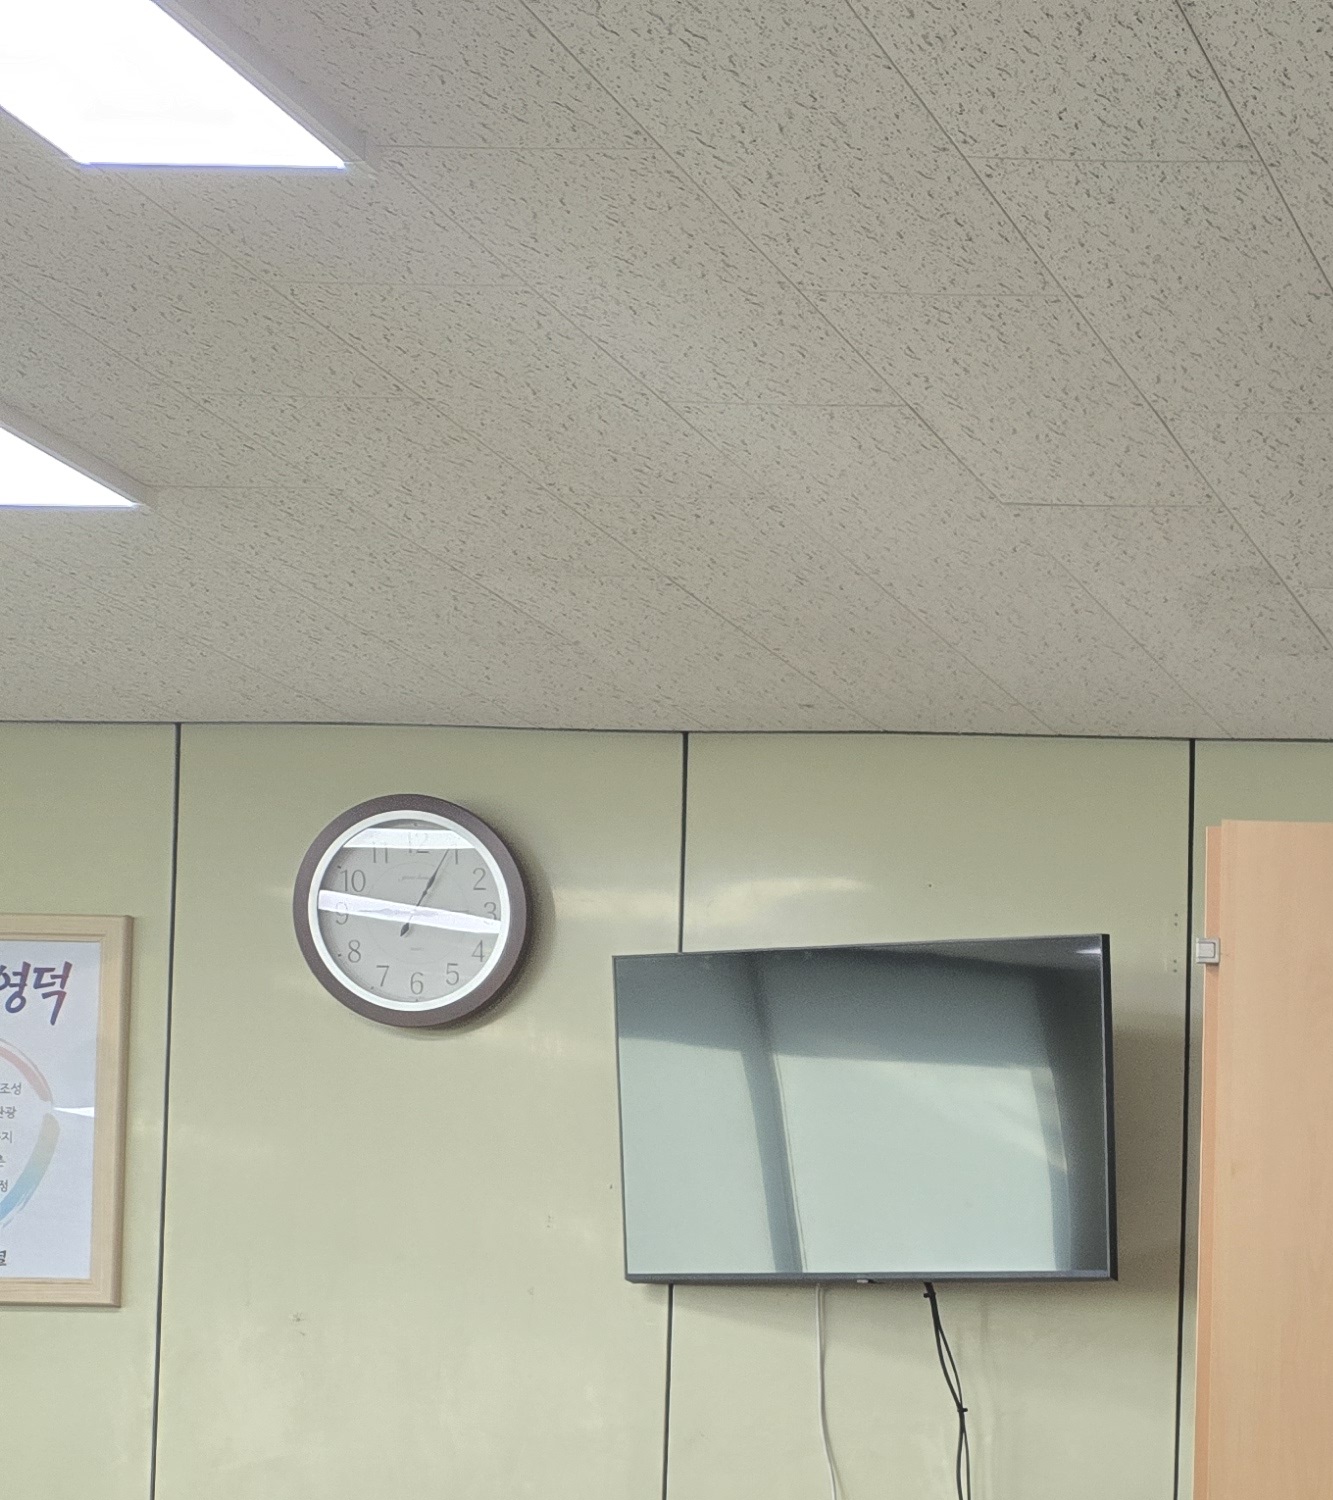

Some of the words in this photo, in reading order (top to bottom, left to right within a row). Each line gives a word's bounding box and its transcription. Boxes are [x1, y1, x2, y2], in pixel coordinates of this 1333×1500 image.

[341, 869, 366, 893] 10
[472, 867, 487, 891] 2
[347, 939, 362, 964] 8
[471, 939, 485, 963] 4
[376, 964, 390, 988] 7
[410, 971, 424, 995] 6
[445, 962, 460, 986] 5
[0, 961, 72, 1026] 영덕
